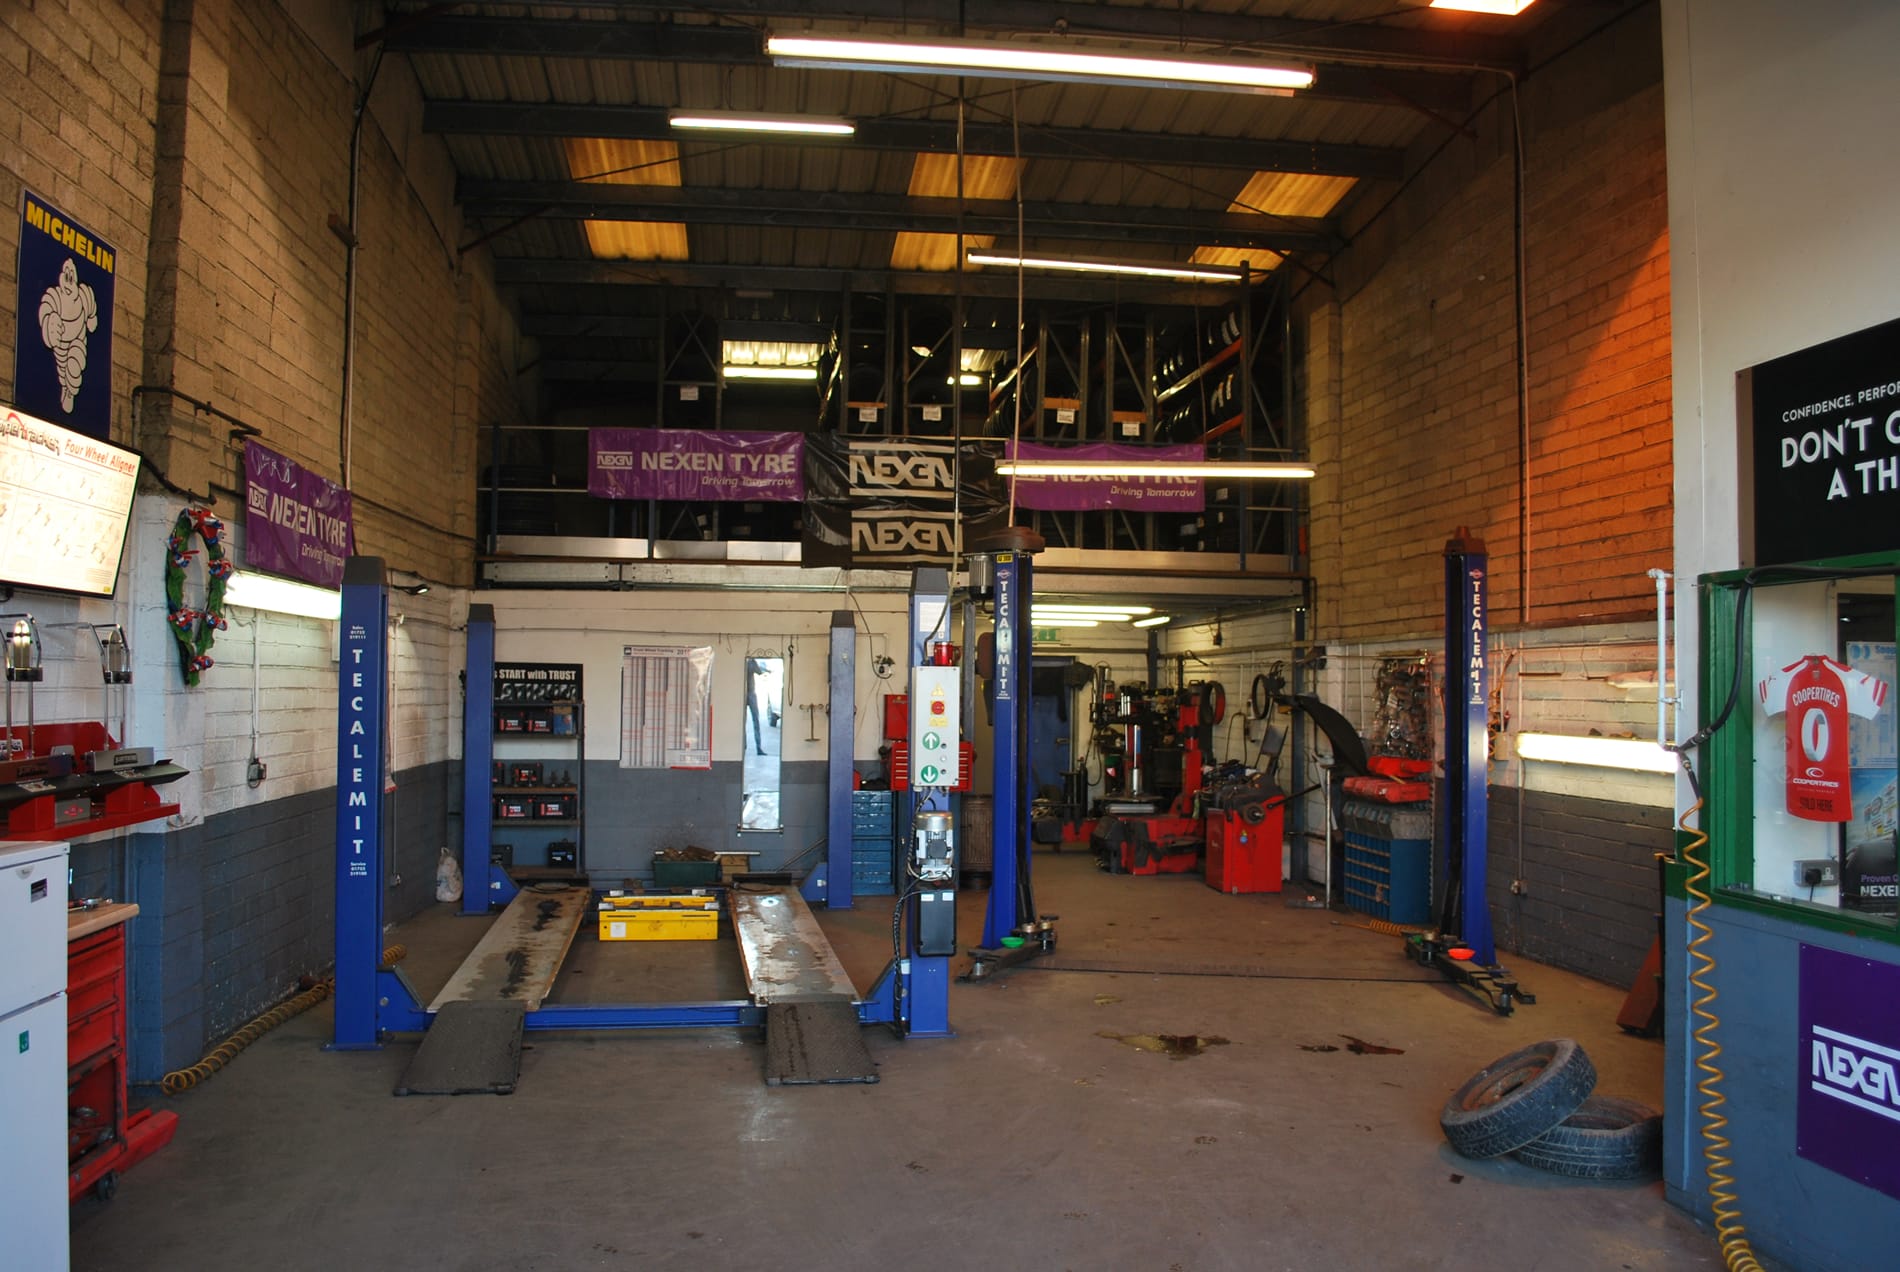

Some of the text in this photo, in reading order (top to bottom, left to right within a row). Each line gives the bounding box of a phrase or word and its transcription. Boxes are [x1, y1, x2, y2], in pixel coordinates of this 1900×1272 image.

[26, 200, 114, 274] MICHELIN
[1782, 395, 1854, 422] CONFIDENCE,
[65, 438, 83, 455] Four
[85, 446, 108, 464] Wheel
[110, 454, 135, 473] Aligner
[1781, 417, 1873, 468] DON'T
[641, 451, 723, 471] NEXEN
[730, 453, 796, 472] TYRE
[849, 455, 955, 488] NEXEN
[702, 476, 795, 488] Driving Tomorrow
[1111, 485, 1196, 498] Driving Tomorrow
[1827, 467, 1848, 500] A
[270, 492, 317, 537] NEXEN
[317, 513, 347, 548] TYRE
[852, 521, 963, 552] NEXEN
[302, 543, 323, 564] Driving
[997, 580, 1010, 690] TECAEMIT
[1470, 581, 1484, 694] TECALEMIT
[499, 669, 526, 679] START
[527, 670, 547, 680] with
[548, 670, 577, 681] TRUST
[1792, 686, 1840, 708] COOPERTIRES
[349, 648, 367, 854] TECALEMIT
[1861, 874, 1891, 883] Proven
[1812, 1039, 1900, 1106] NEXEN
